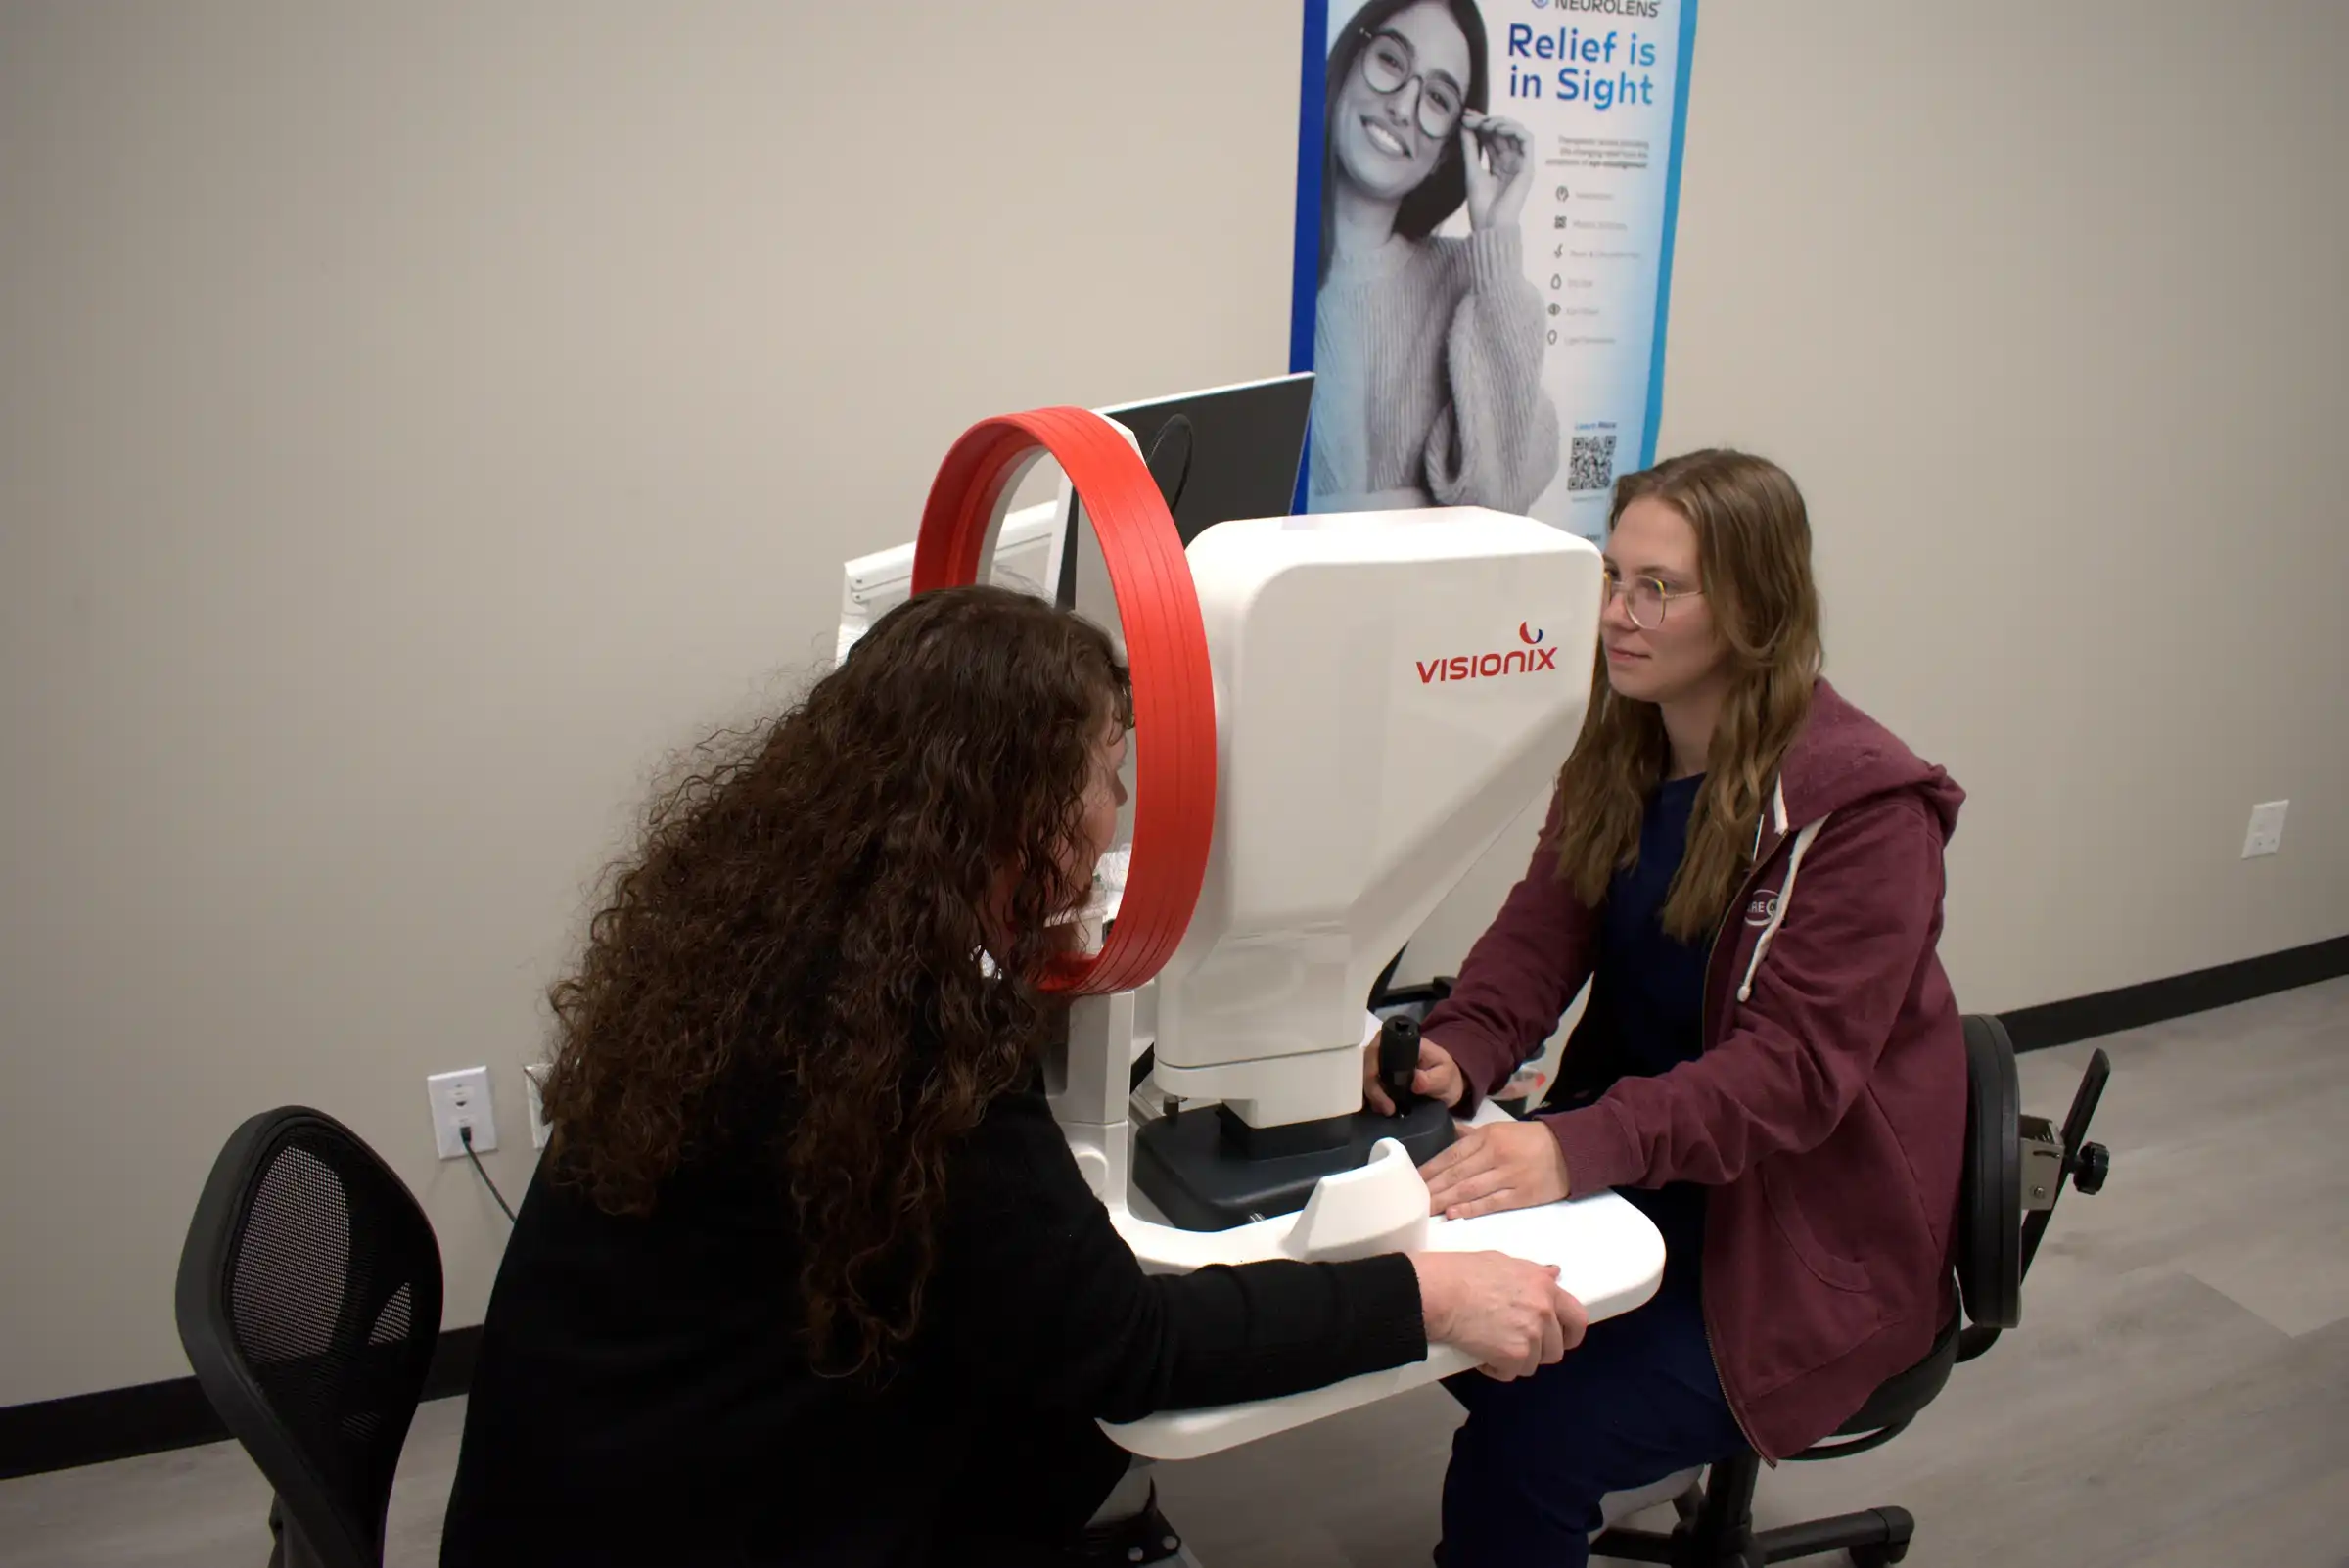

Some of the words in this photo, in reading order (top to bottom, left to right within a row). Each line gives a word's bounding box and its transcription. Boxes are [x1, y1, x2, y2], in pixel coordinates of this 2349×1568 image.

[1555, 0, 1659, 18] NEUROLENS
[1508, 23, 1617, 63] Relief
[1630, 32, 1656, 66] is
[1510, 64, 1542, 98] in
[1556, 67, 1654, 111] Sight
